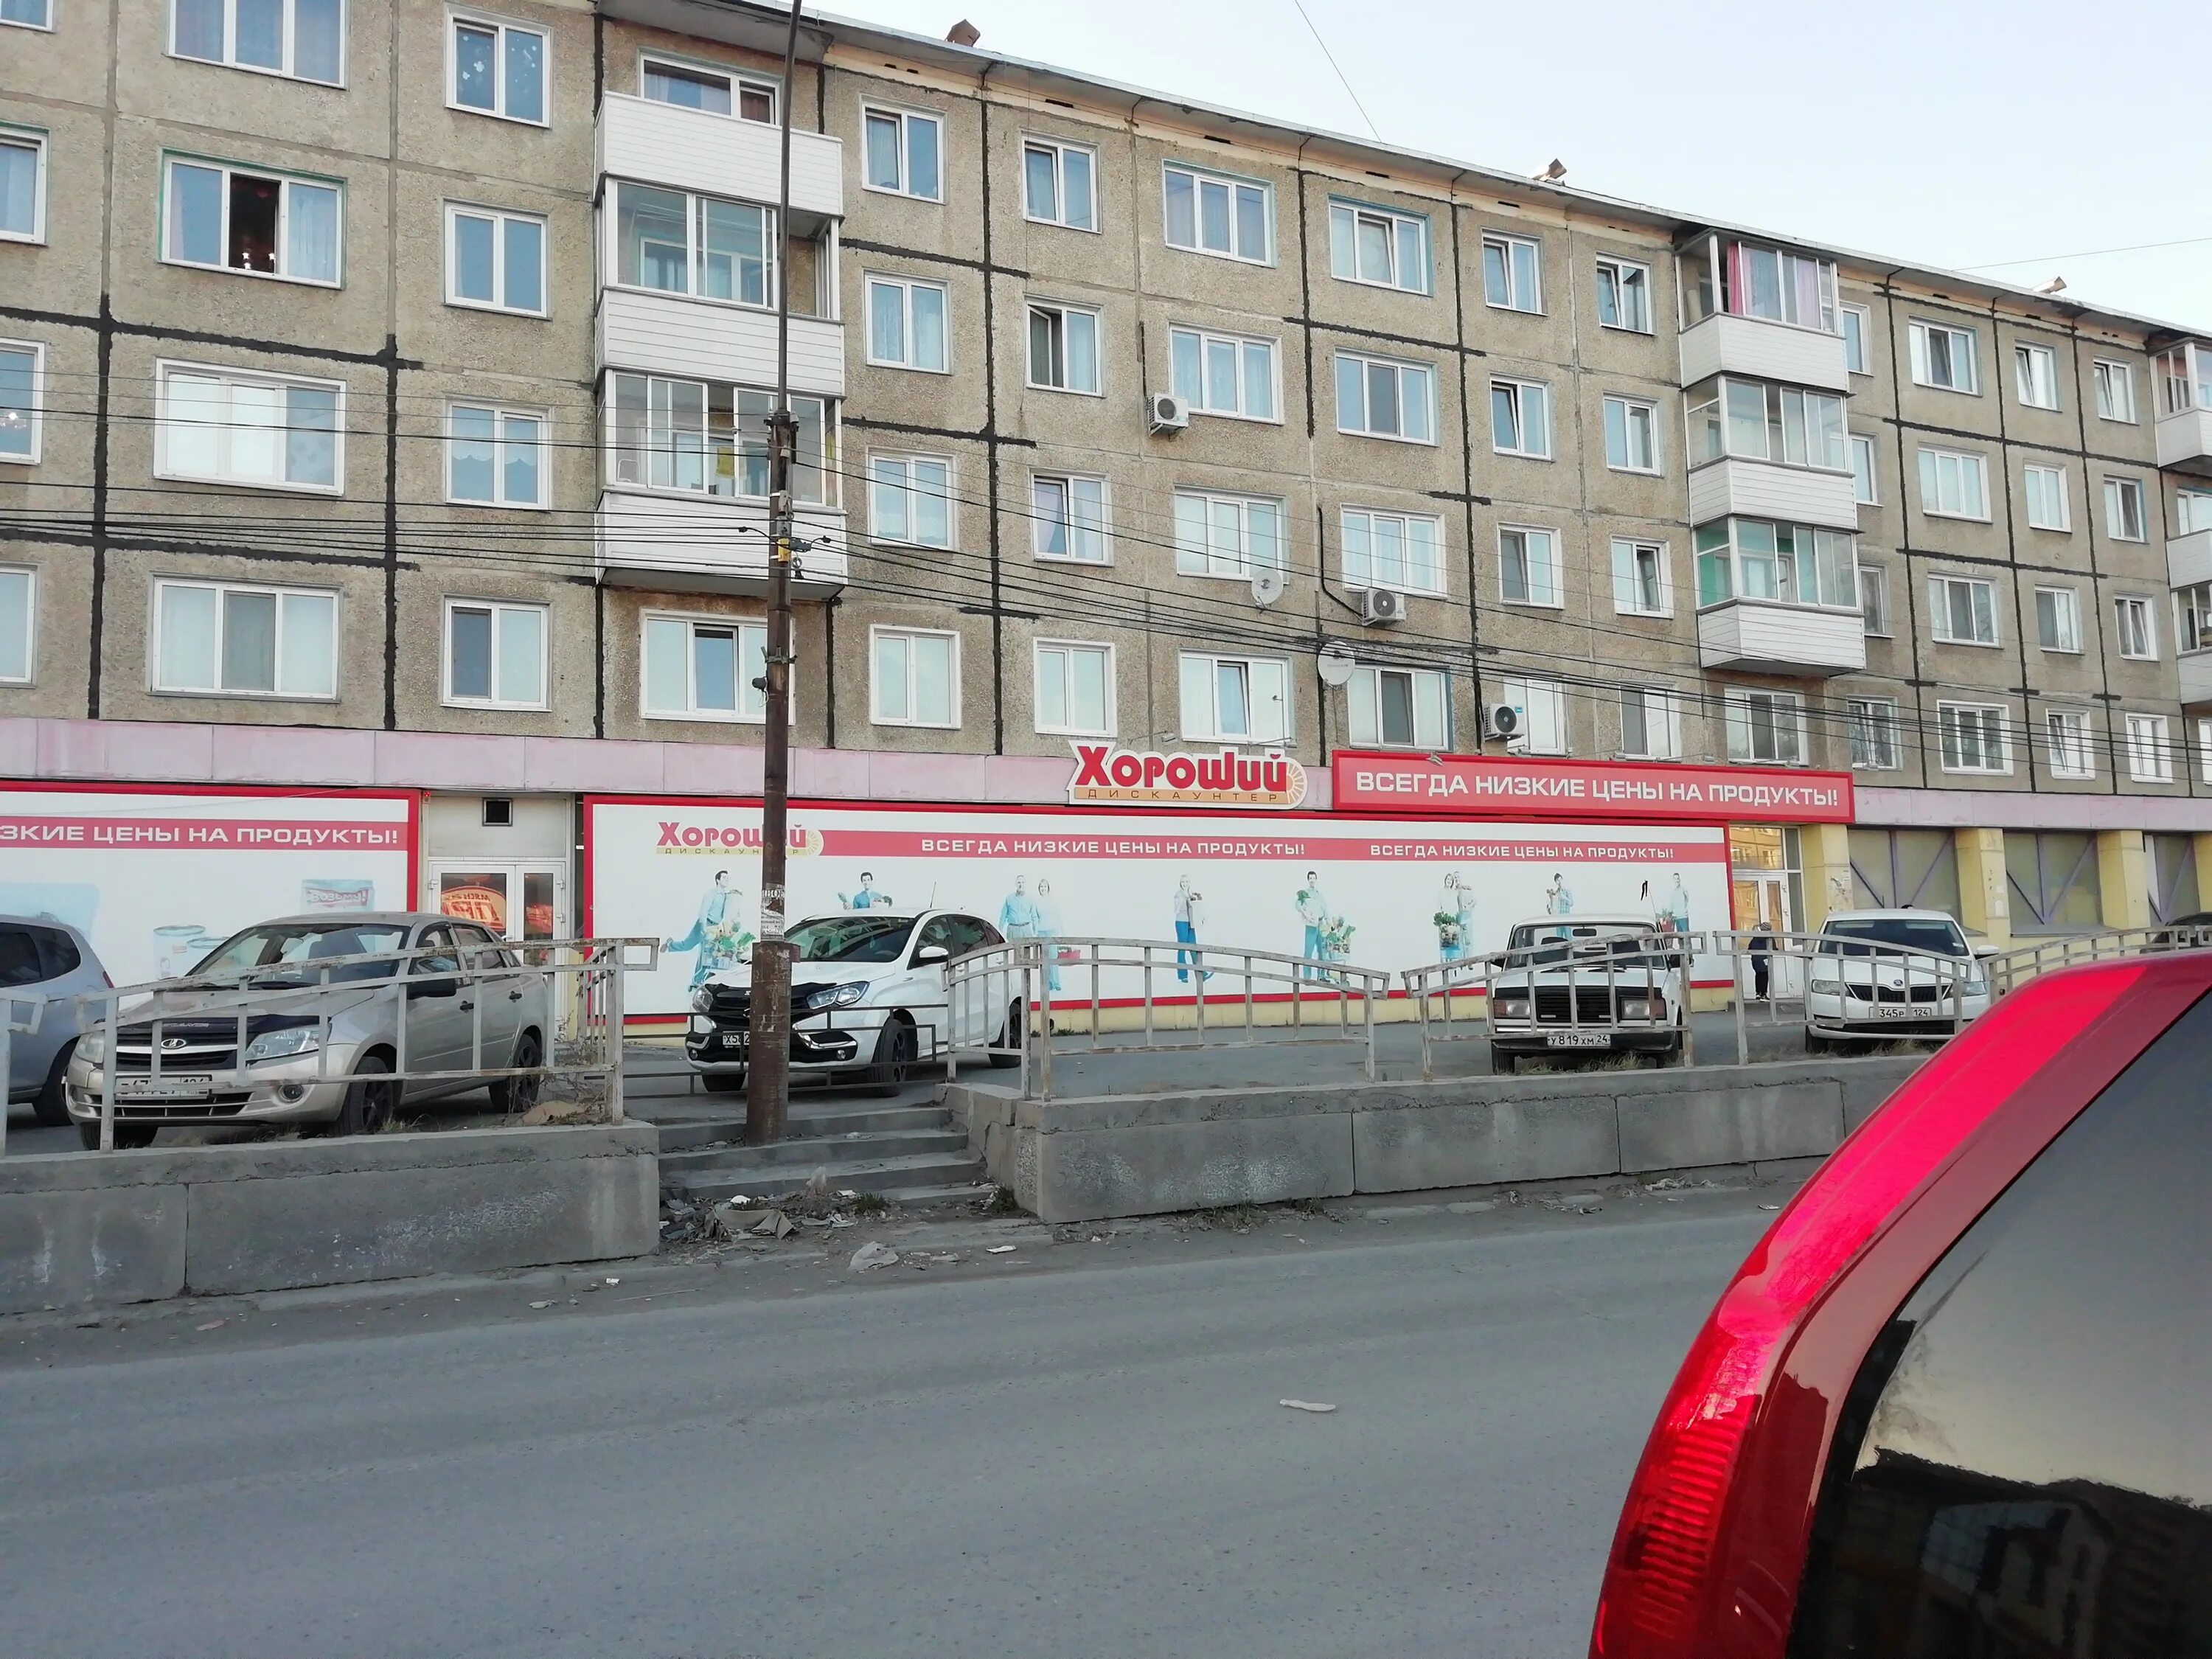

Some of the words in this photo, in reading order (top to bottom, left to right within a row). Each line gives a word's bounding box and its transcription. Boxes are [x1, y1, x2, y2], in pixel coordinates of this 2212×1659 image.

[1088, 789, 1278, 801] ДИСКАУНТЕР
[1356, 772, 1469, 798] ВСЕГДА
[1475, 776, 1585, 797] НИЗКИЕ
[1592, 779, 1663, 801] ЦЕНЫ
[1669, 783, 1703, 801] НА
[1709, 784, 1838, 807] ПРОДУКТЫ!
[94, 827, 179, 844] ЦЕНЫ
[188, 827, 229, 842] НА
[237, 828, 397, 846] ПРОДУКТЫ!
[657, 821, 807, 848] Хорошй
[921, 839, 1008, 855] ВСЕГДА
[1014, 841, 1099, 853] НИЗКИЕ
[1105, 842, 1161, 855] ЦЕНЫ
[1166, 842, 1192, 854] НА
[1197, 843, 1305, 856] ПРОДУКТЫ!
[1370, 845, 1438, 858] ВСЕГДА
[1442, 846, 1510, 857] НИЗКИЕ
[1514, 846, 1558, 858] ЦЕНЫ
[1563, 847, 1584, 857] НА
[1587, 847, 1674, 860] ПРОДУКТЫ!
[1596, 1034, 1607, 1043] 24
